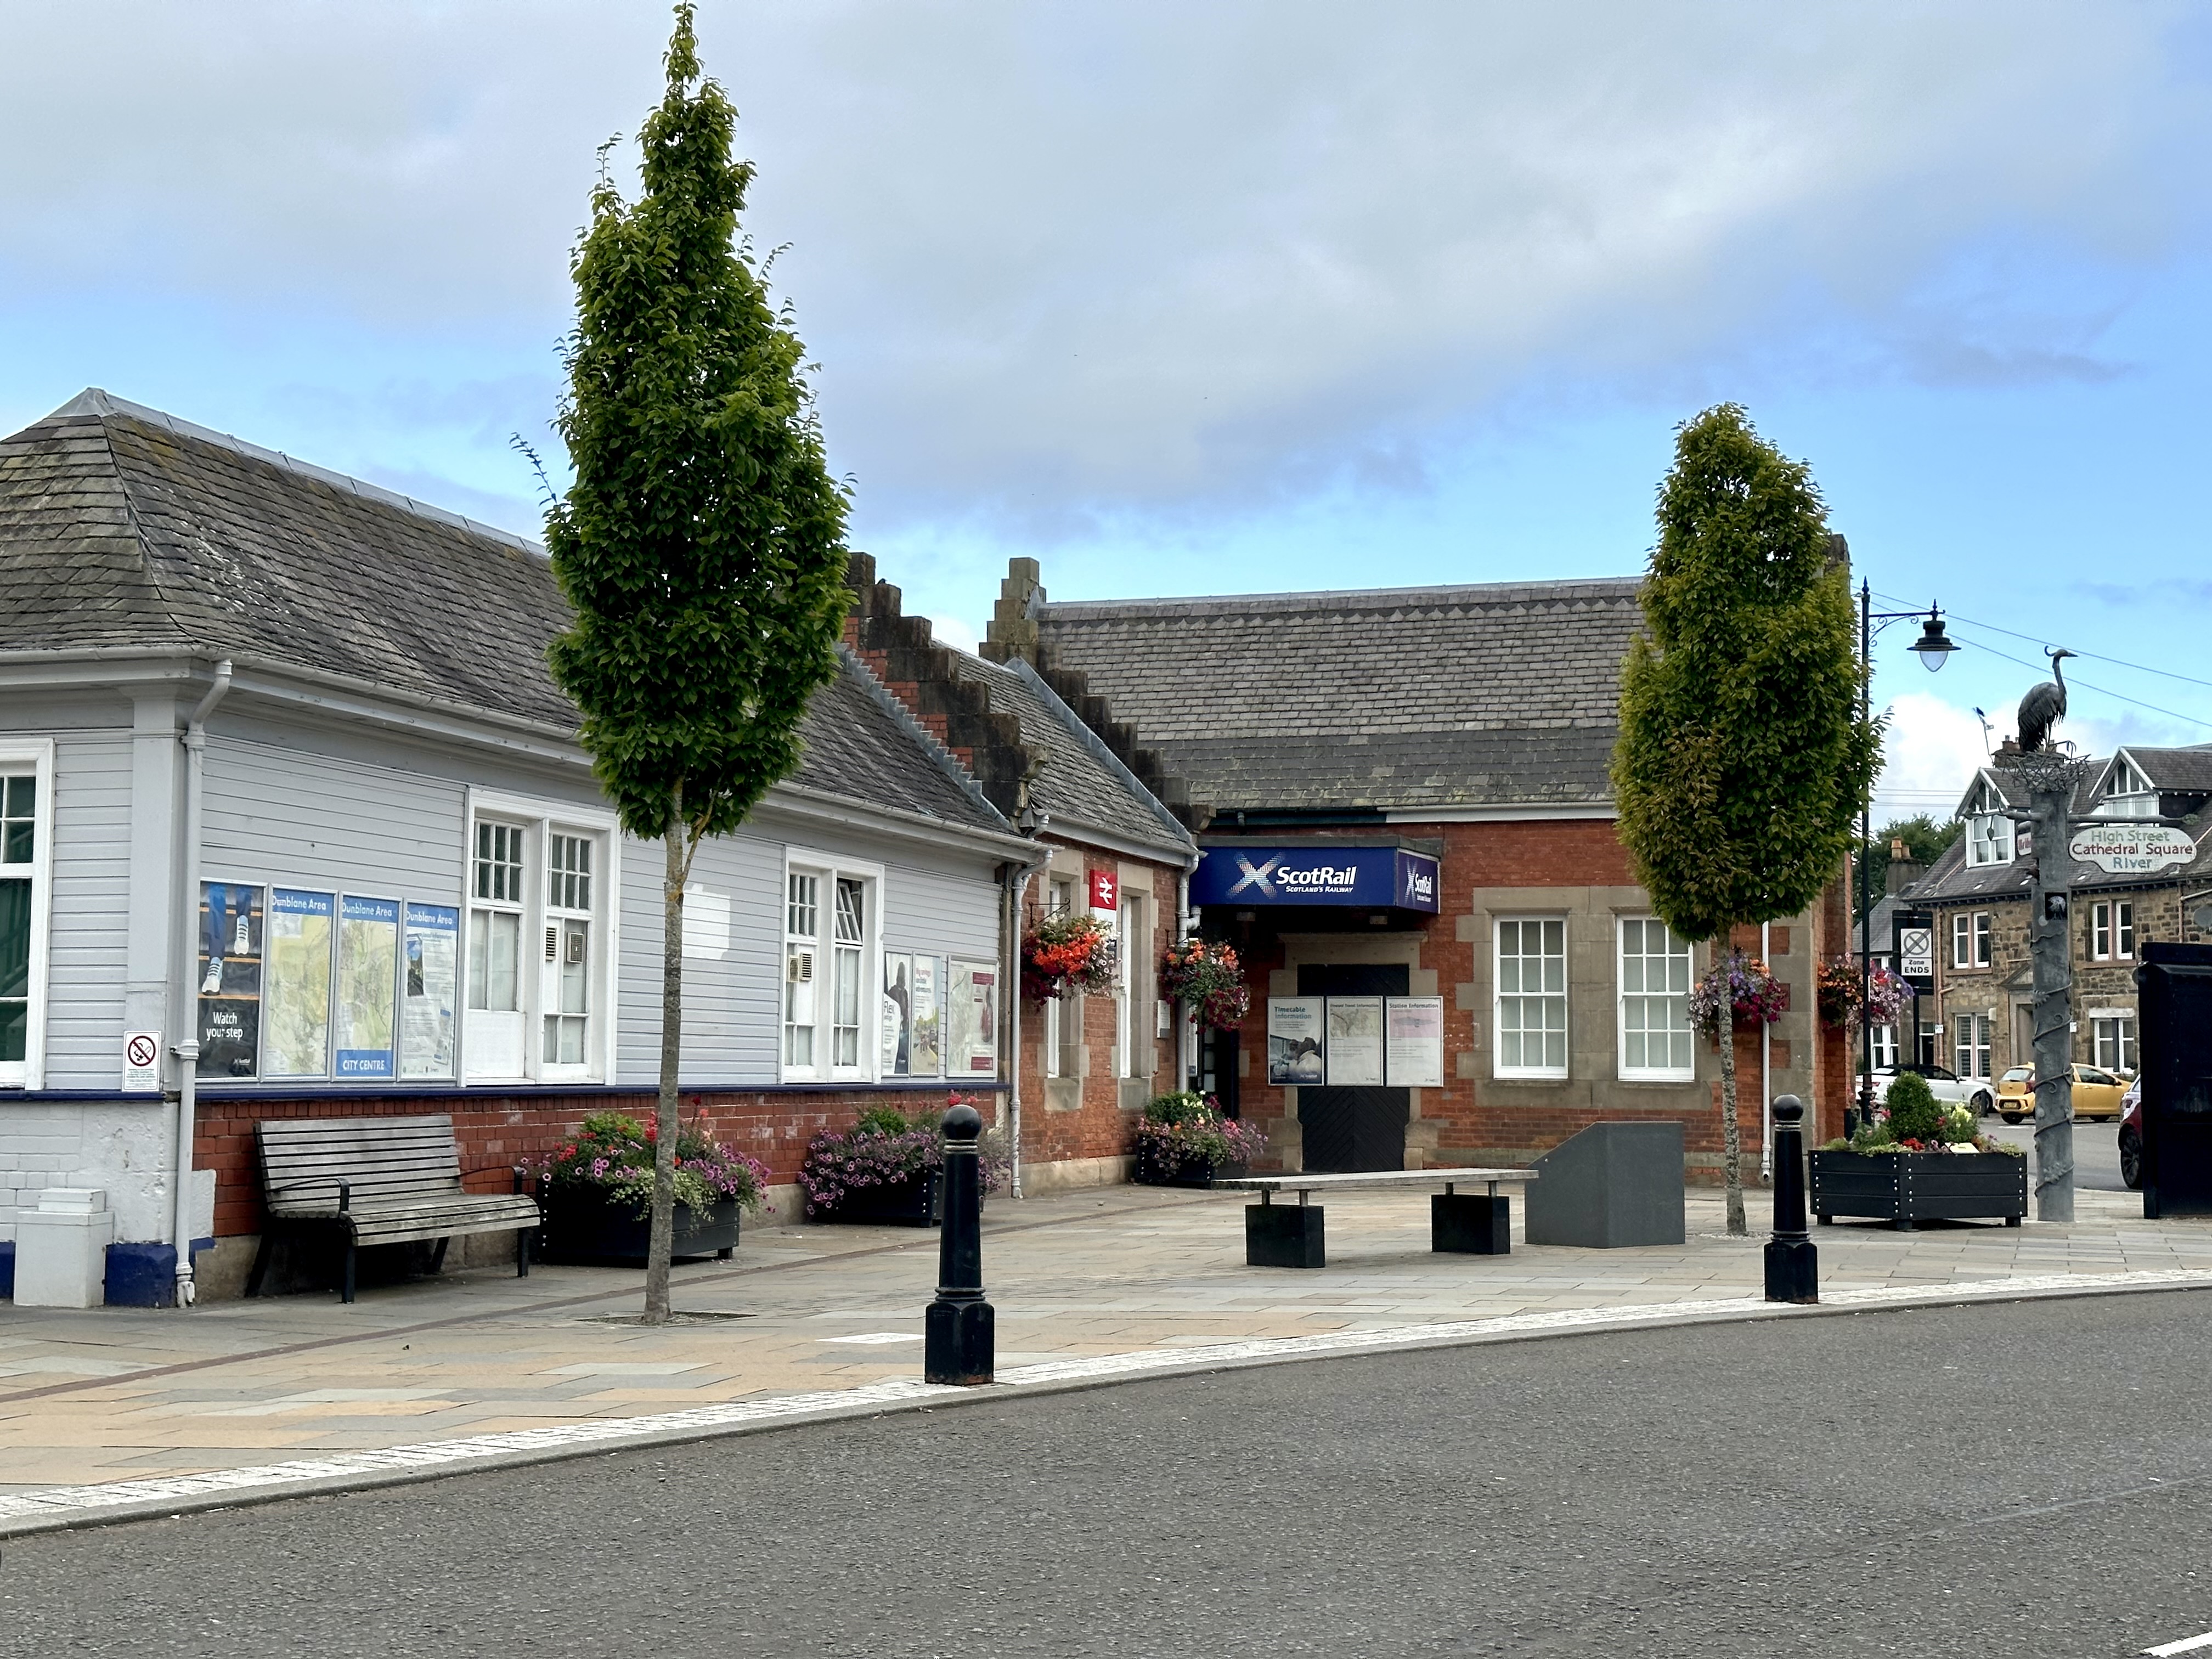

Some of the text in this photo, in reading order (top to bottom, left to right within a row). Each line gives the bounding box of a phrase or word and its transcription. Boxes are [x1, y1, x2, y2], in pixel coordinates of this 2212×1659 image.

[2128, 830, 2170, 842] Street
[2072, 843, 2193, 857] Cathedral Square
[2113, 857, 2152, 868] River
[1276, 866, 1357, 885] ScotRail
[272, 895, 326, 911] Dunblane Area
[342, 902, 392, 917] Dunblane Area
[437, 914, 453, 925] Area
[213, 1012, 238, 1025] Watch
[206, 1027, 243, 1041] your step
[343, 1059, 385, 1071] CITY CENTRE
